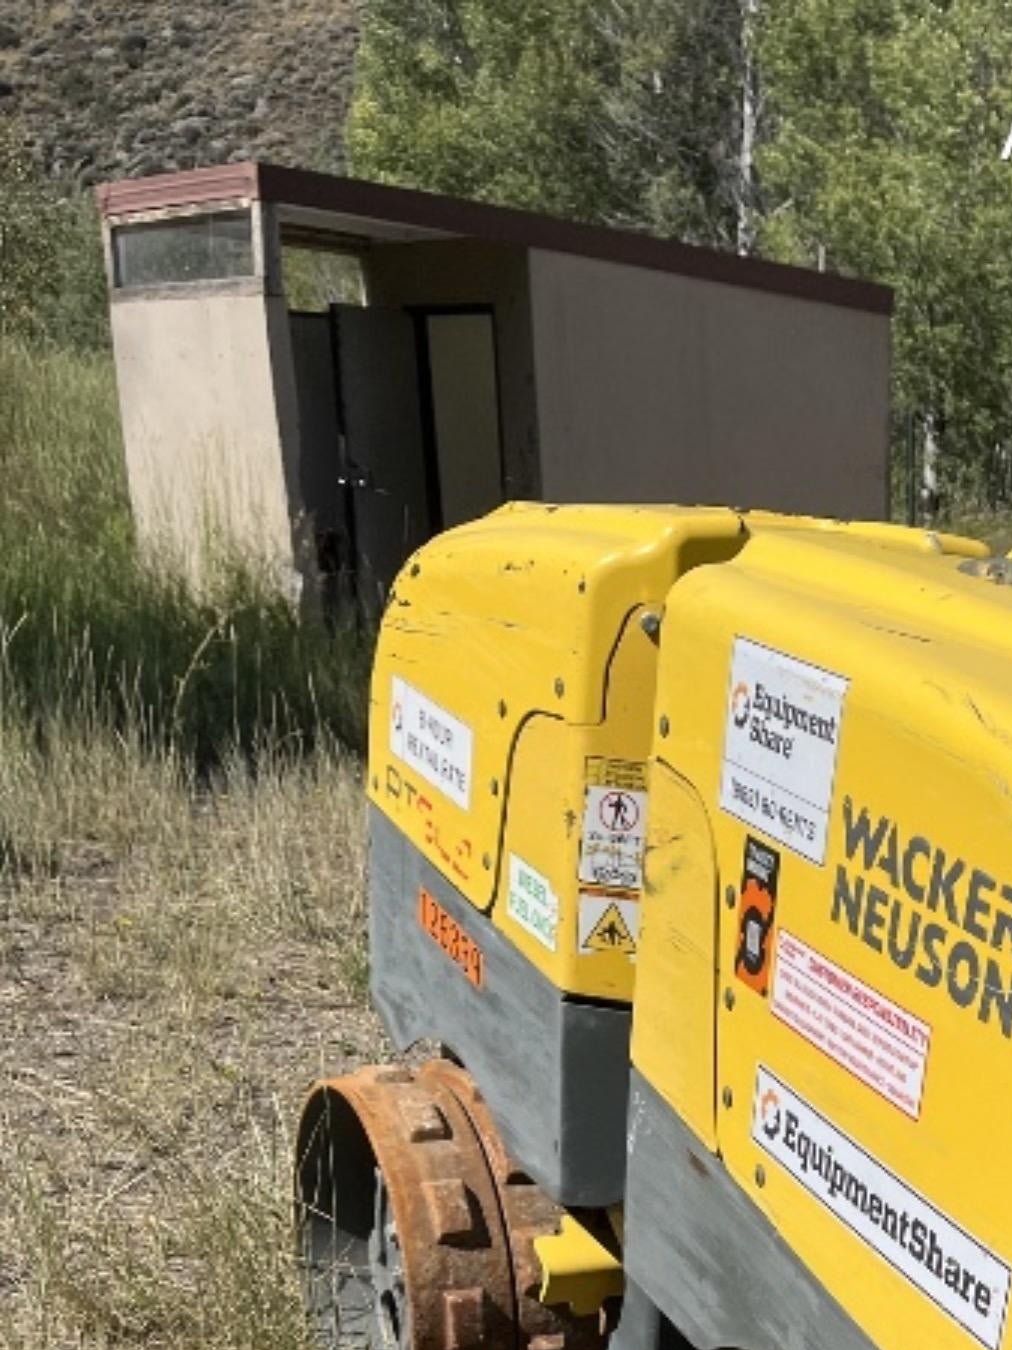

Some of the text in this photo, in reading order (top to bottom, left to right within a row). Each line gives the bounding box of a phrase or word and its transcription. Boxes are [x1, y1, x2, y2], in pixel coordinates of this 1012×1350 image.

[749, 716, 793, 760] Share
[752, 683, 836, 745] Equipment
[782, 1109, 991, 1317] EquipmentShare
